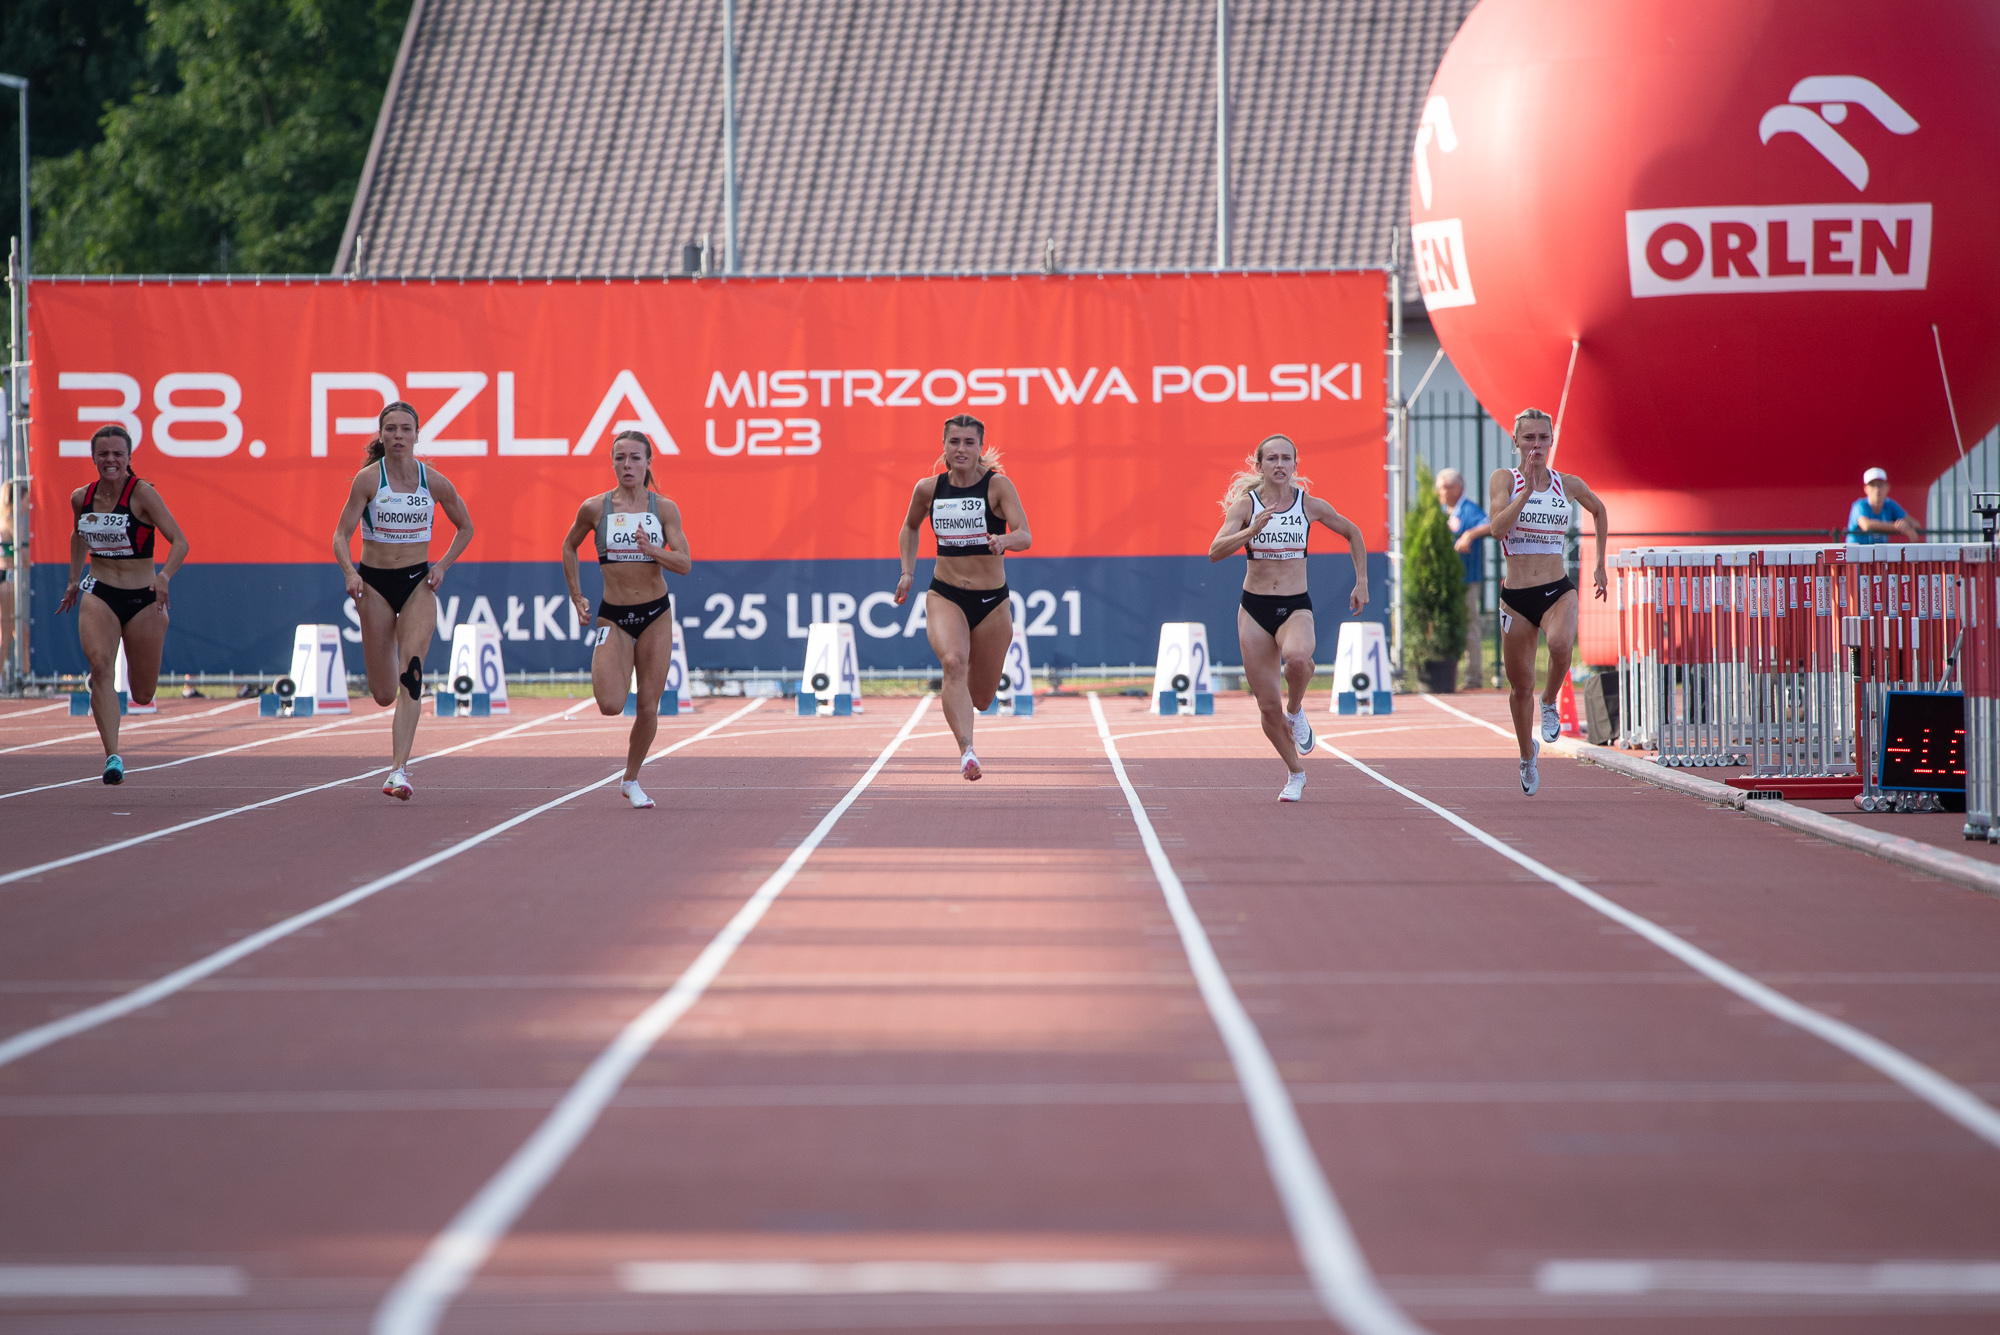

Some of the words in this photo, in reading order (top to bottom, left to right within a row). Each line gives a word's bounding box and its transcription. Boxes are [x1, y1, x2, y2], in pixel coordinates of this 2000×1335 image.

[1646, 219, 1912, 281] ORLEN
[704, 366, 1139, 408] MISTRZOSTWA
[1152, 362, 1362, 403] POLSKI
[58, 372, 267, 458] 38.
[311, 369, 680, 457] PZLA
[705, 418, 822, 456] U23
[407, 495, 428, 506] 385
[961, 500, 982, 511] 339
[1551, 497, 1566, 508] 52
[103, 515, 124, 526] 393
[377, 511, 428, 524] HOROWSKA
[645, 514, 652, 525] 5
[935, 516, 984, 530] STEFANOWICZ
[1280, 515, 1302, 526] 214
[1519, 511, 1569, 526] BORZEWSKA
[1253, 532, 1305, 544] POTASZNIK
[1501, 614, 1508, 628] 1
[299, 644, 312, 693] 7
[320, 643, 338, 694] 7
[481, 643, 499, 693] 6
[842, 642, 855, 692] 4
[1010, 642, 1025, 691] 3
[1192, 641, 1208, 690] 2
[1367, 640, 1383, 692] 1
